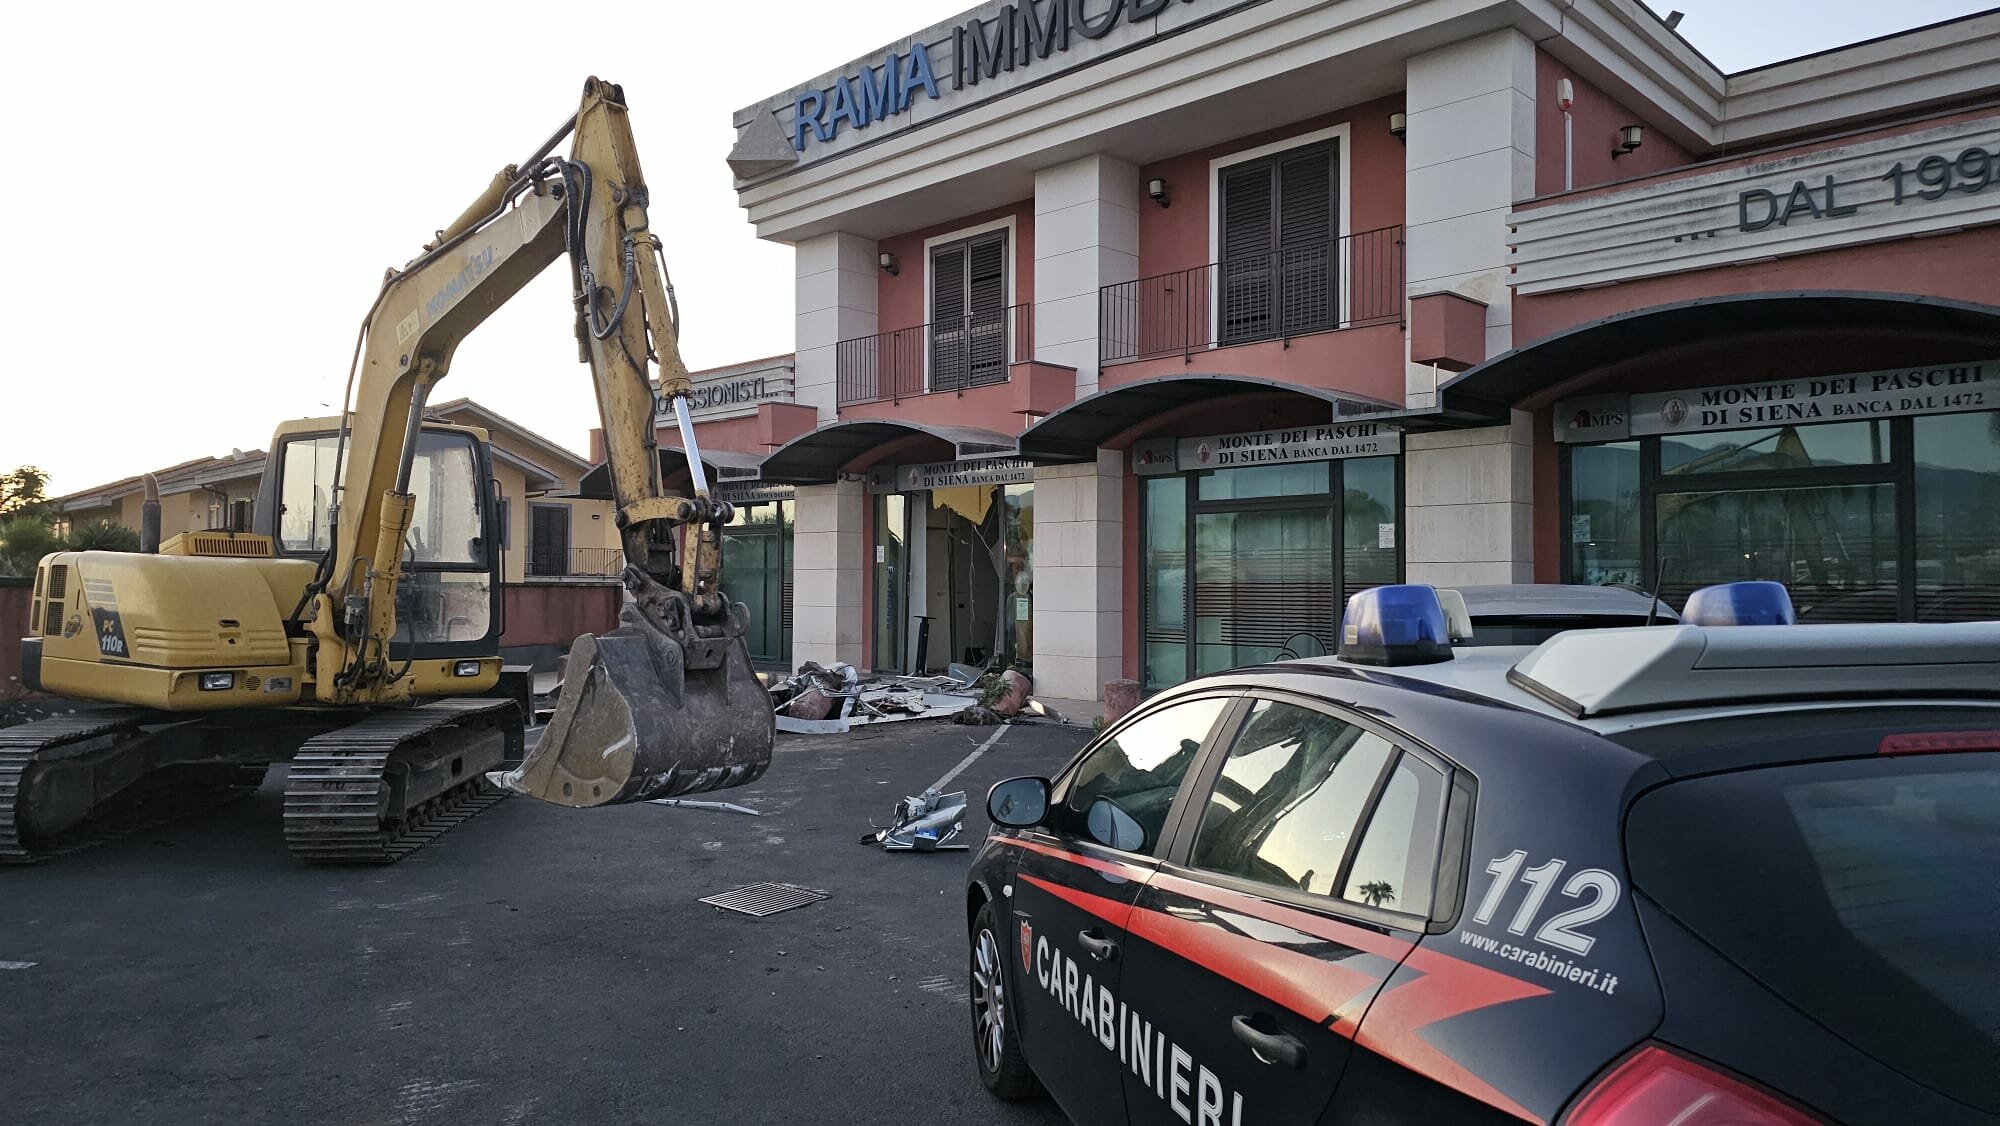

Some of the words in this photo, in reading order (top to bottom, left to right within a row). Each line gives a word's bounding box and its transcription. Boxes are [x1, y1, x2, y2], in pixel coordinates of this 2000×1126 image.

[795, 43, 939, 151] RAMA
[952, 0, 1192, 90] IMMO
[1738, 175, 1858, 233] DAL
[1882, 147, 2000, 205] 199
[1700, 384, 1795, 406] MONTE
[1809, 376, 1856, 397] DEI
[1871, 366, 1984, 392] PASCHI
[1591, 413, 1623, 427] MPS
[1701, 409, 1728, 426] DI
[1739, 402, 1822, 422] SIENA
[1832, 400, 1893, 416] BANCA
[1900, 396, 1937, 411] DAL
[1943, 392, 1984, 407] 1472
[1219, 433, 1273, 449] MONTE
[1281, 430, 1308, 443] DEI
[1316, 423, 1378, 440] PASCHI
[1219, 452, 1235, 464] DI
[1240, 447, 1288, 462] SIENA
[1294, 447, 1328, 458] BANCA
[1331, 445, 1352, 455] DAL
[1355, 442, 1378, 453] 1472
[923, 463, 959, 475] MONTE
[963, 461, 981, 471] DEI
[923, 477, 934, 487] DI
[938, 474, 968, 486] SIENA
[1010, 472, 1025, 480] 1472
[103, 620, 114, 632] PC
[102, 635, 123, 652] 110R
[1473, 849, 1621, 957] 112
[1460, 930, 1618, 995] www.carabinieri.it
